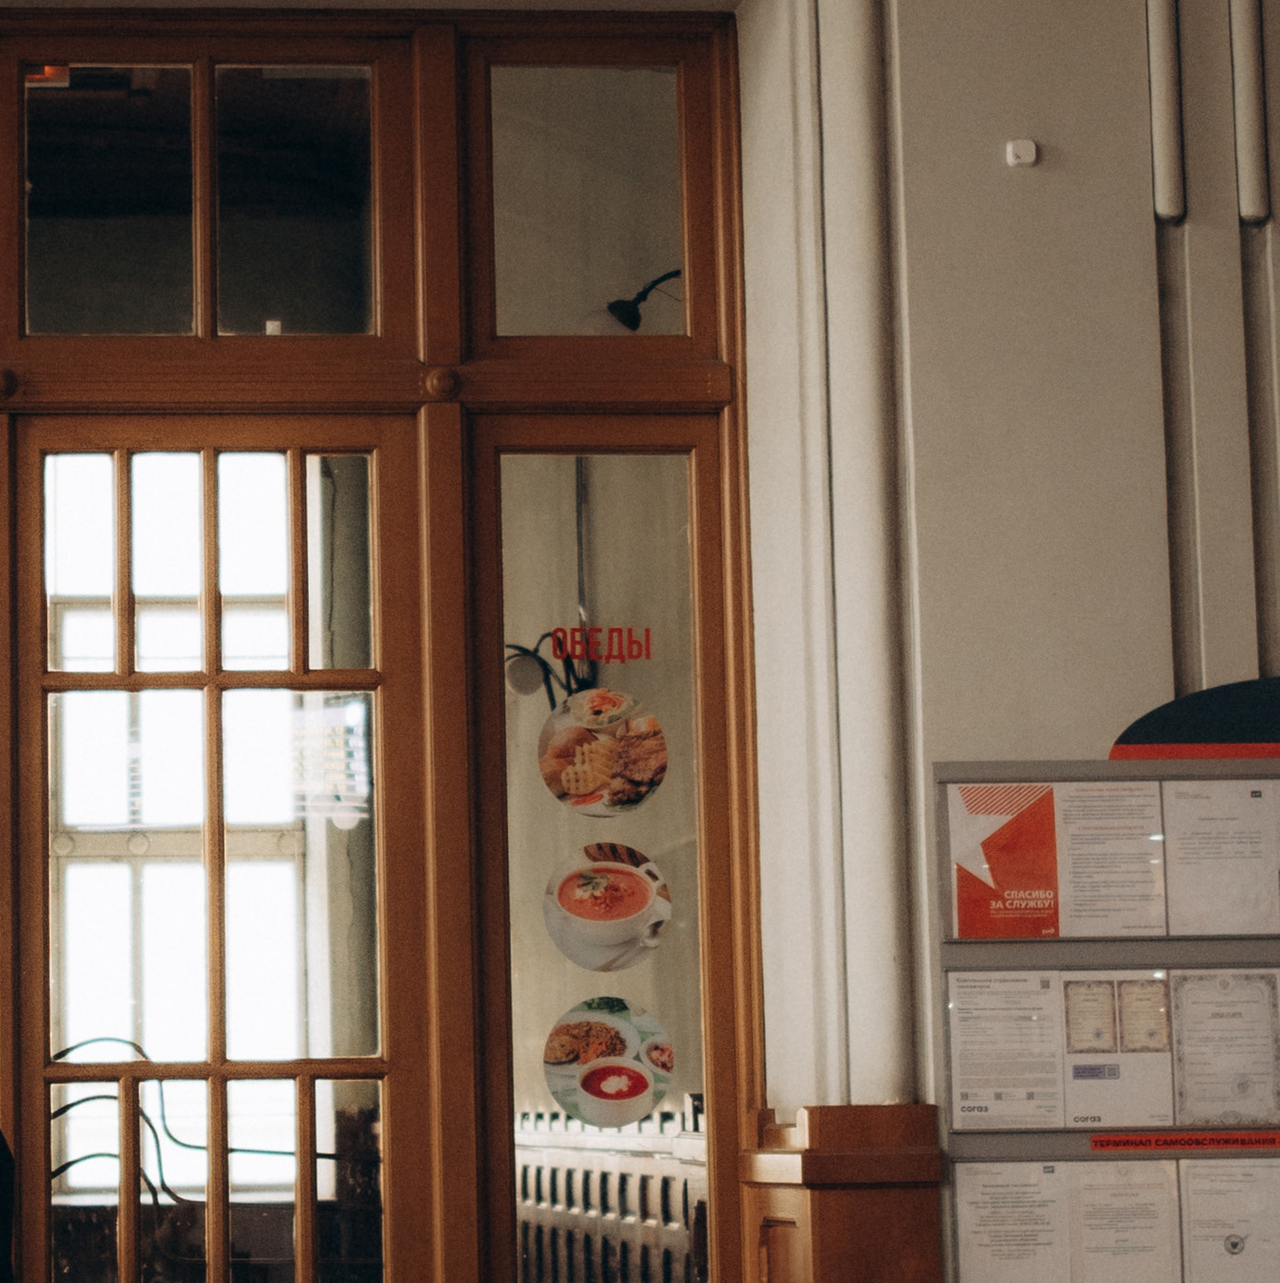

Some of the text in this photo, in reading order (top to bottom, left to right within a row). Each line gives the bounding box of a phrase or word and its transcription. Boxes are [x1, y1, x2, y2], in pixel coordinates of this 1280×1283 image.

[552, 627, 651, 664] ОБЕДЫ
[1004, 890, 1054, 899] СПАСИБО
[990, 899, 1054, 909] ЗА СЛУЖБУ!
[1092, 1137, 1276, 1148] ТЕРМИНАЛ САМООБСЛУЖИВАНИЯ
